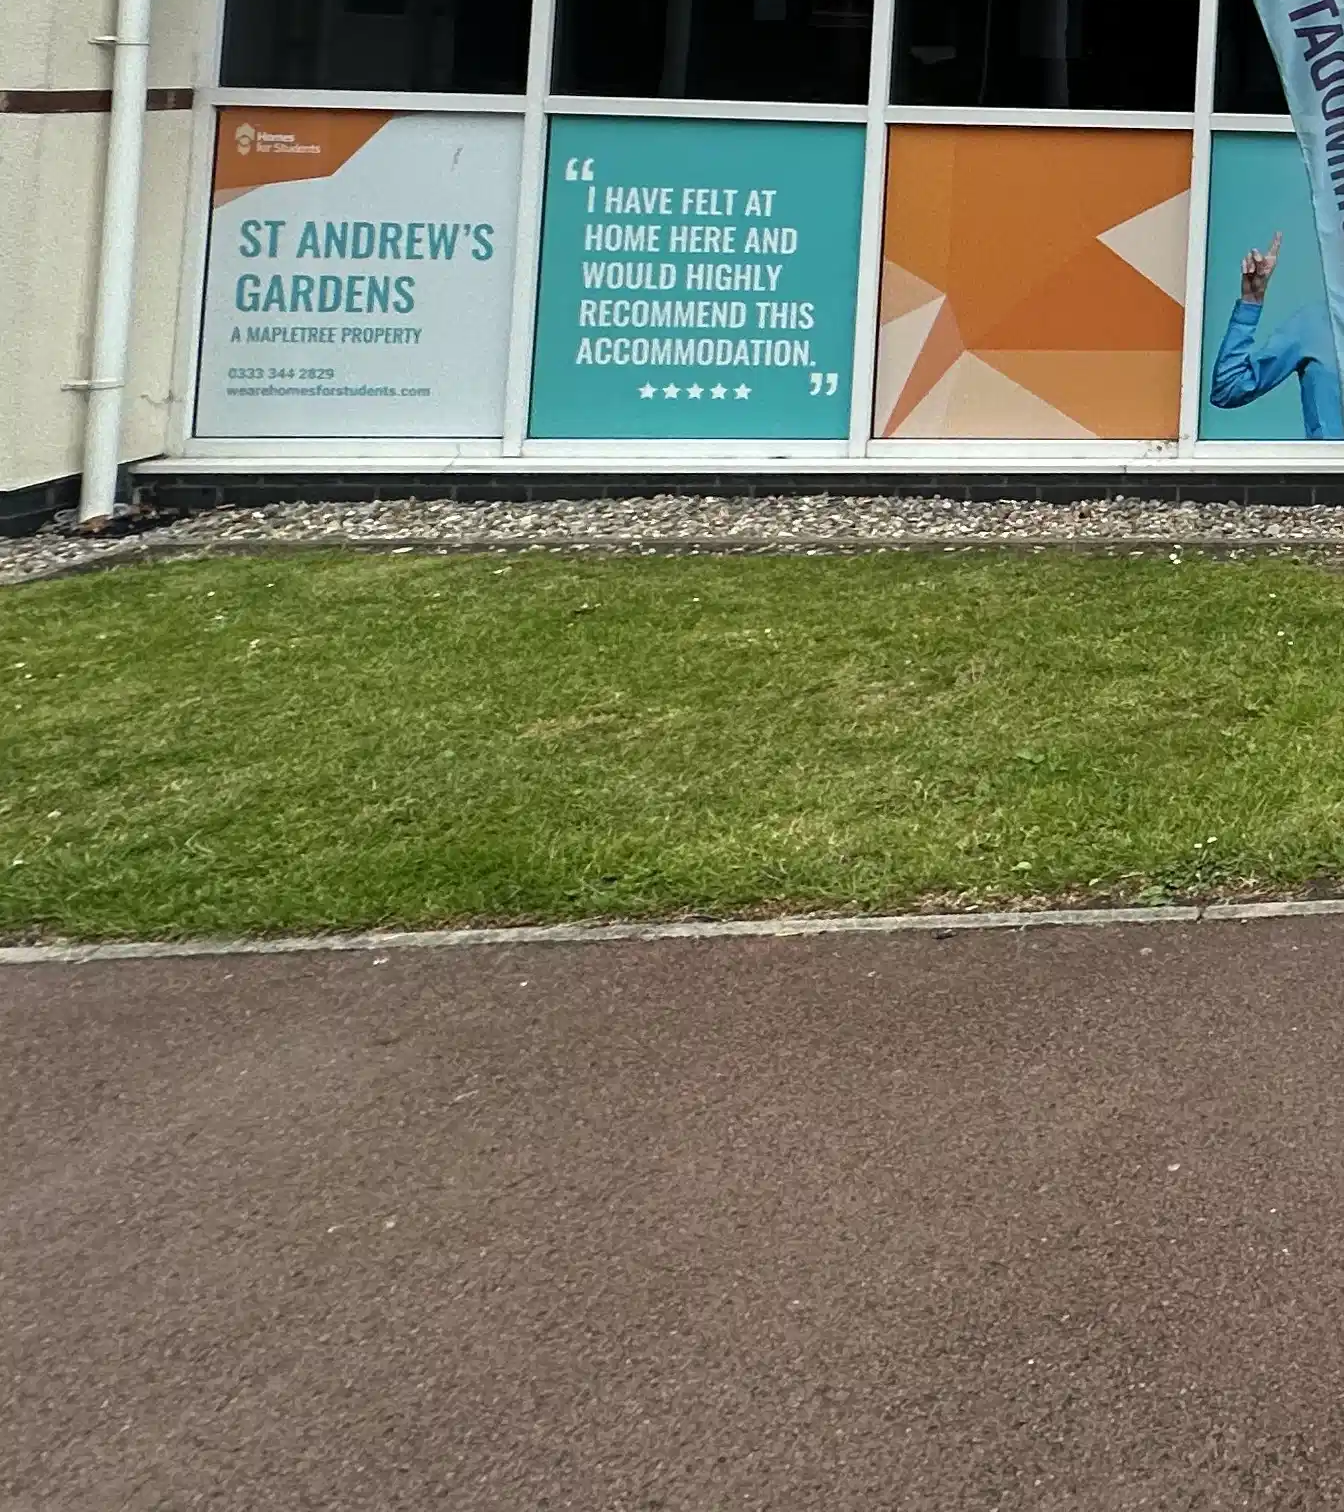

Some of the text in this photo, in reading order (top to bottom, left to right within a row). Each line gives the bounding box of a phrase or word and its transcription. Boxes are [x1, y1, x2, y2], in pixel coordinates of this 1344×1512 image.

[587, 185, 777, 217] I HAVE FELT AT
[239, 219, 495, 261] ST ANDREW'S
[584, 223, 798, 255] HOME HERE AND
[581, 261, 783, 292] WOULD HIGHLY
[235, 273, 416, 314] GARDENS
[579, 299, 815, 330] RECOMMEND THIS
[231, 326, 422, 345] A MAPLETREE PROPERTY
[575, 336, 817, 367] ACCOMMODATION.
[228, 368, 335, 380] 0333 344 2829
